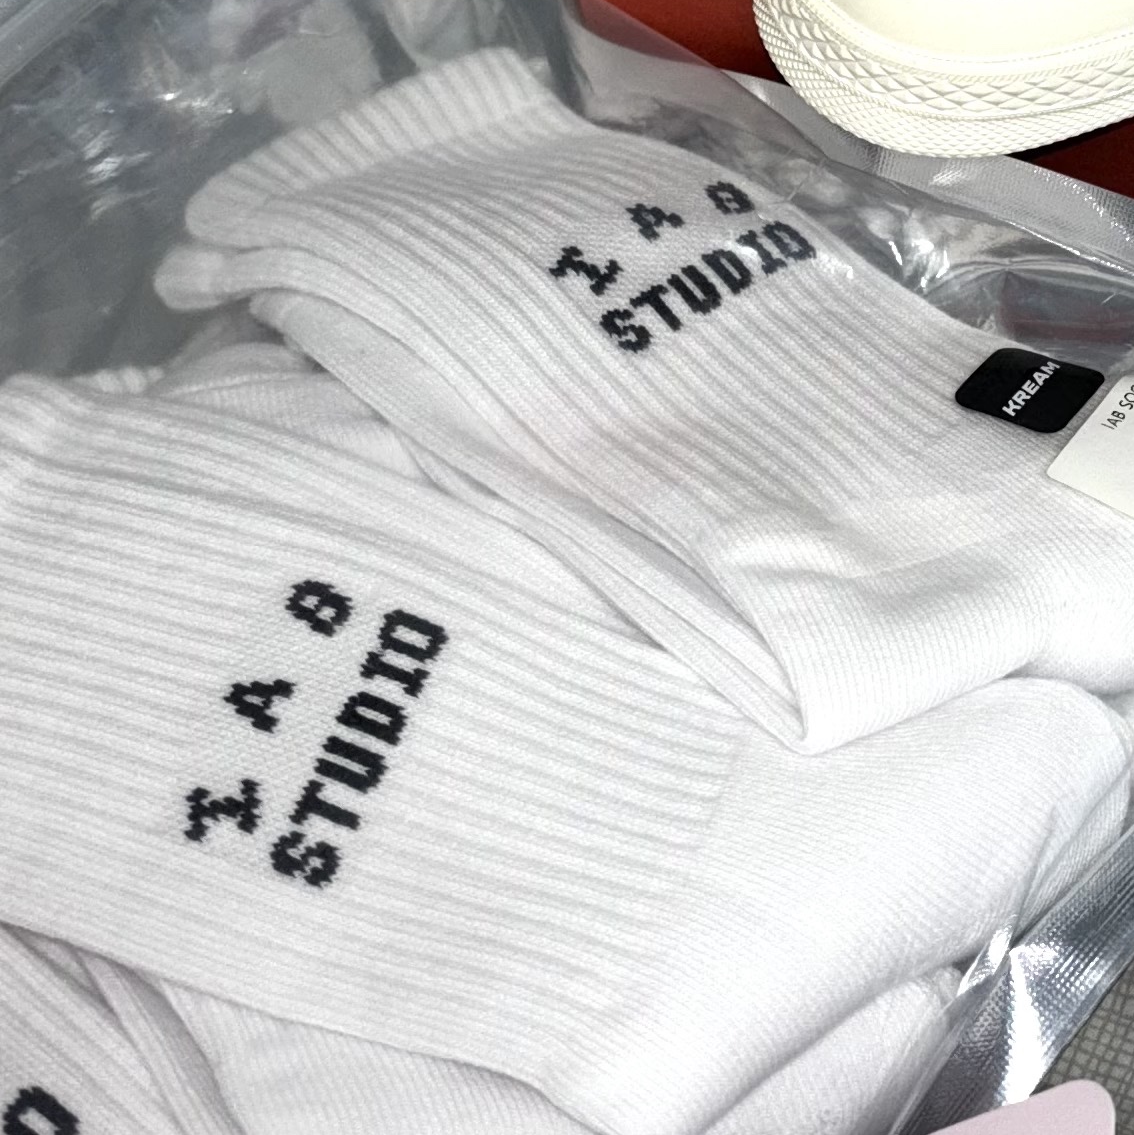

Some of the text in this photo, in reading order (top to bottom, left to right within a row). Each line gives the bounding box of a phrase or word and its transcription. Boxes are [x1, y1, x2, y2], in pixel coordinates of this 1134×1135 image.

[600, 221, 816, 353] STUDIO
[1002, 361, 1060, 417] KREAM
[1101, 410, 1126, 430] IAB
[269, 609, 449, 889] STUDIO
